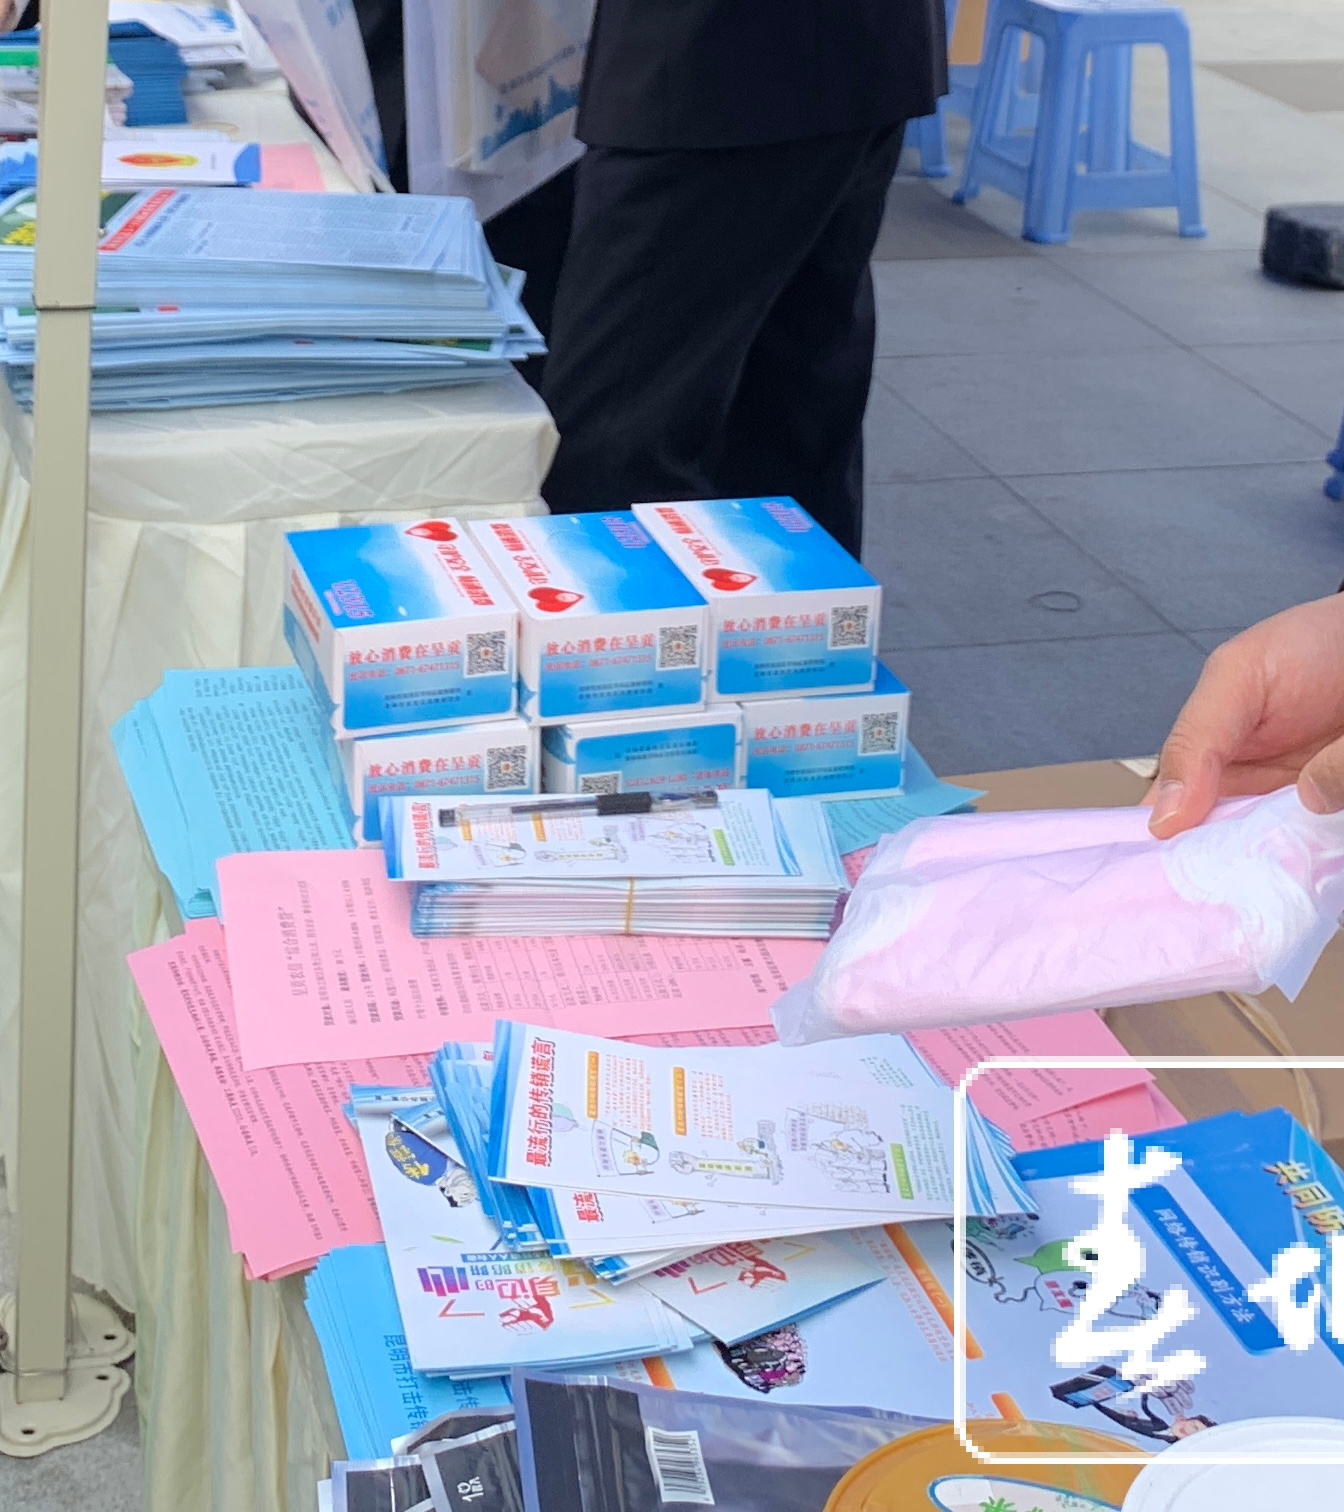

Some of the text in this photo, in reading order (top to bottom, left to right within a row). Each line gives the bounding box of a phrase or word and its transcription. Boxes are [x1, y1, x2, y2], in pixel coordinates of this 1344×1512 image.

[525, 1037, 562, 1169] 最流行的传销谎言
[1152, 1207, 1255, 1325] 网络传销识别方法
